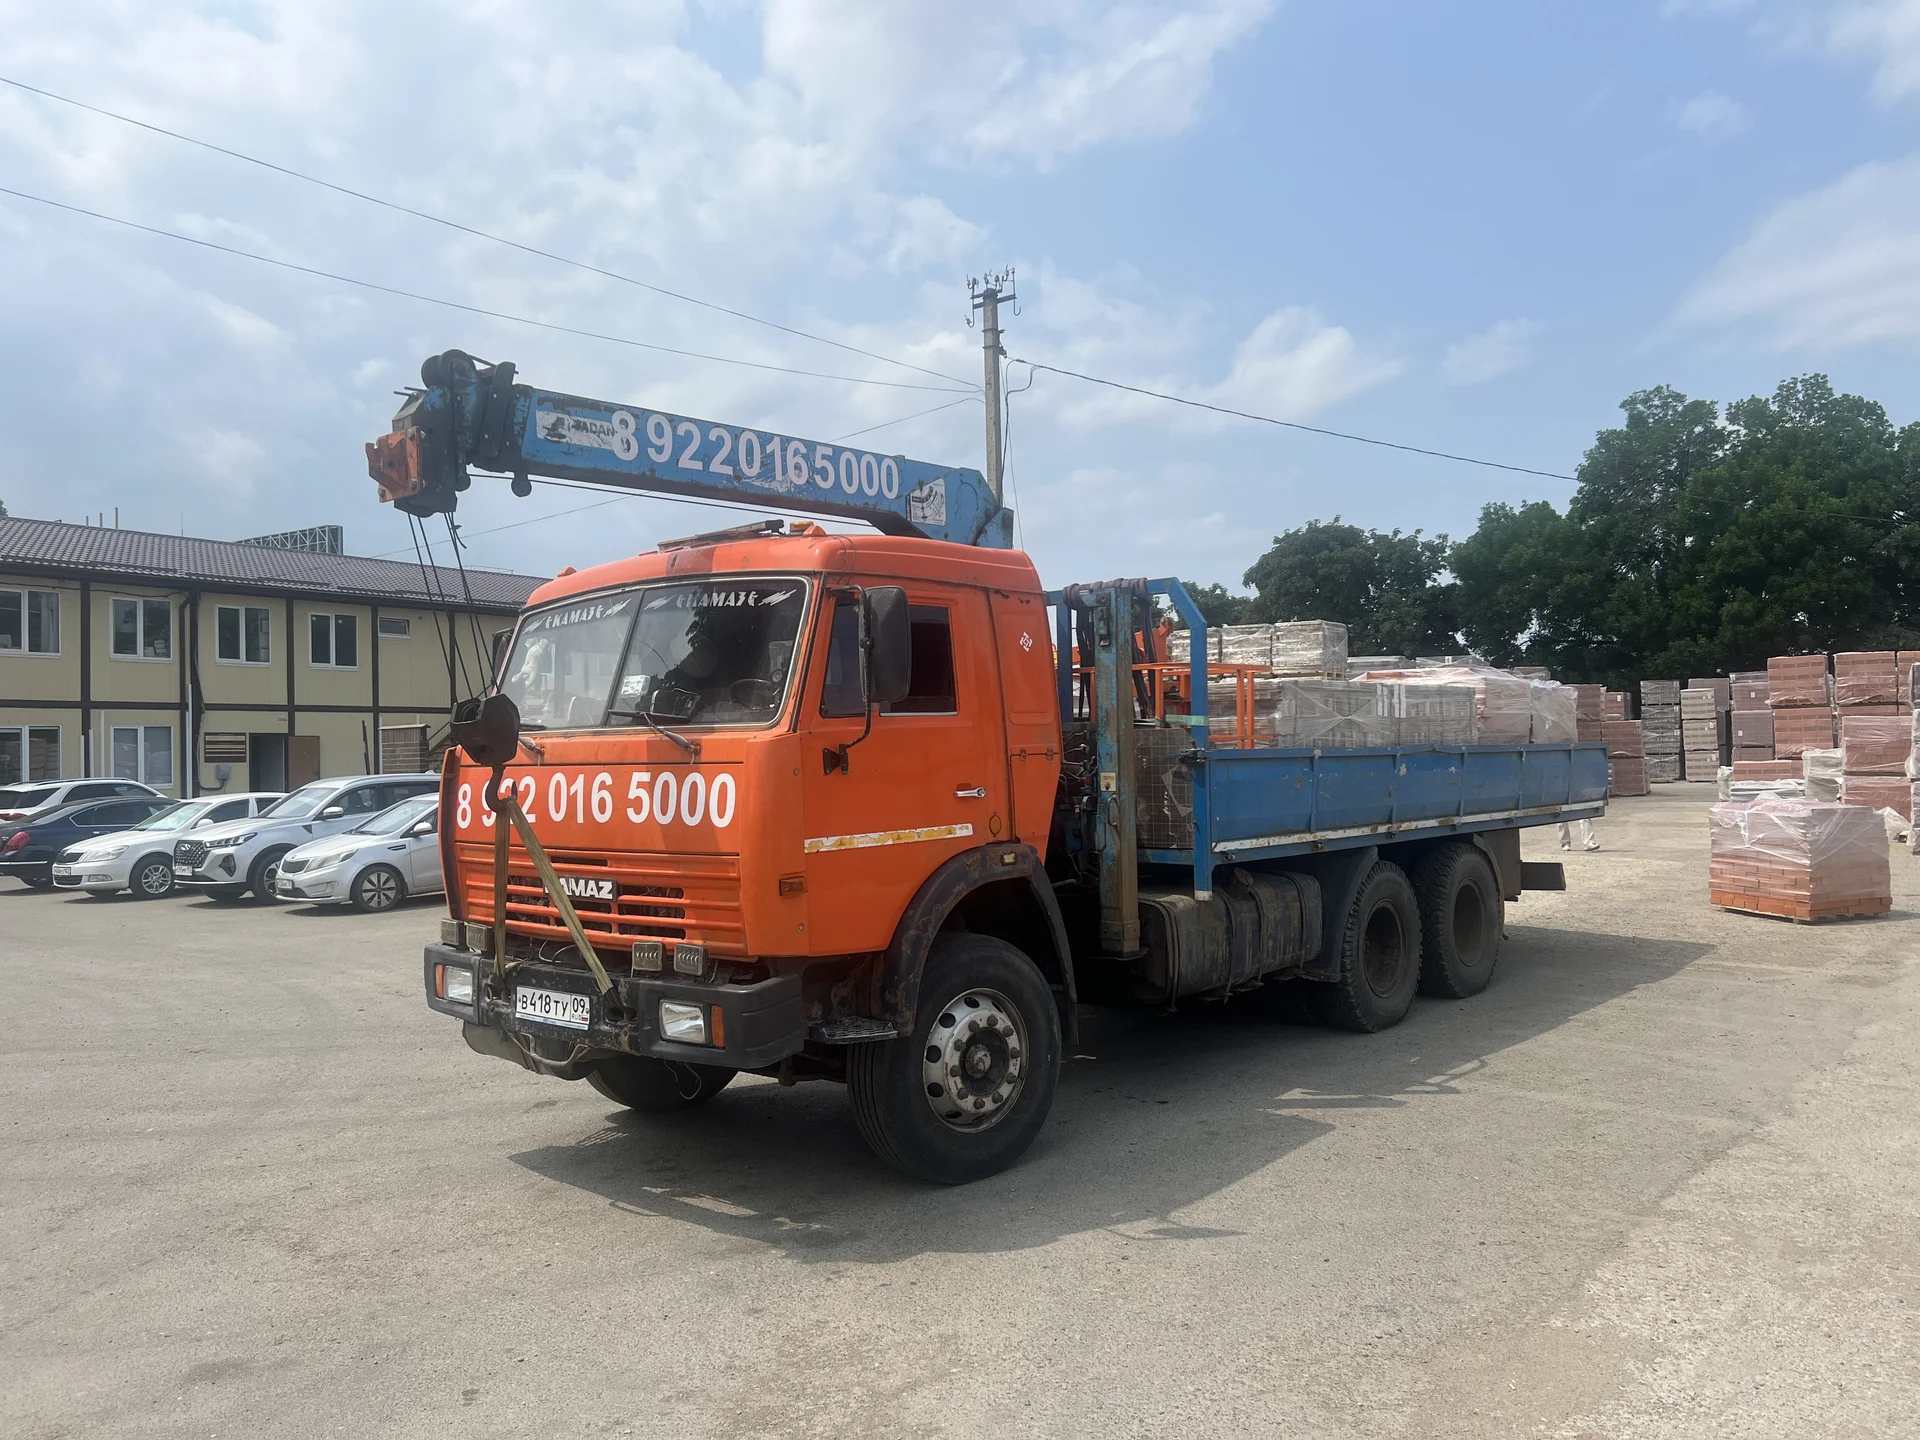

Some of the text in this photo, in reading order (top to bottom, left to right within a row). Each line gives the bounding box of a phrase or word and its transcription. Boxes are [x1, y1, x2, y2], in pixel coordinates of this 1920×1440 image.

[457, 783, 472, 829] 8
[548, 772, 613, 824] 016
[626, 771, 736, 828] 5000
[545, 877, 613, 899] AMAZ
